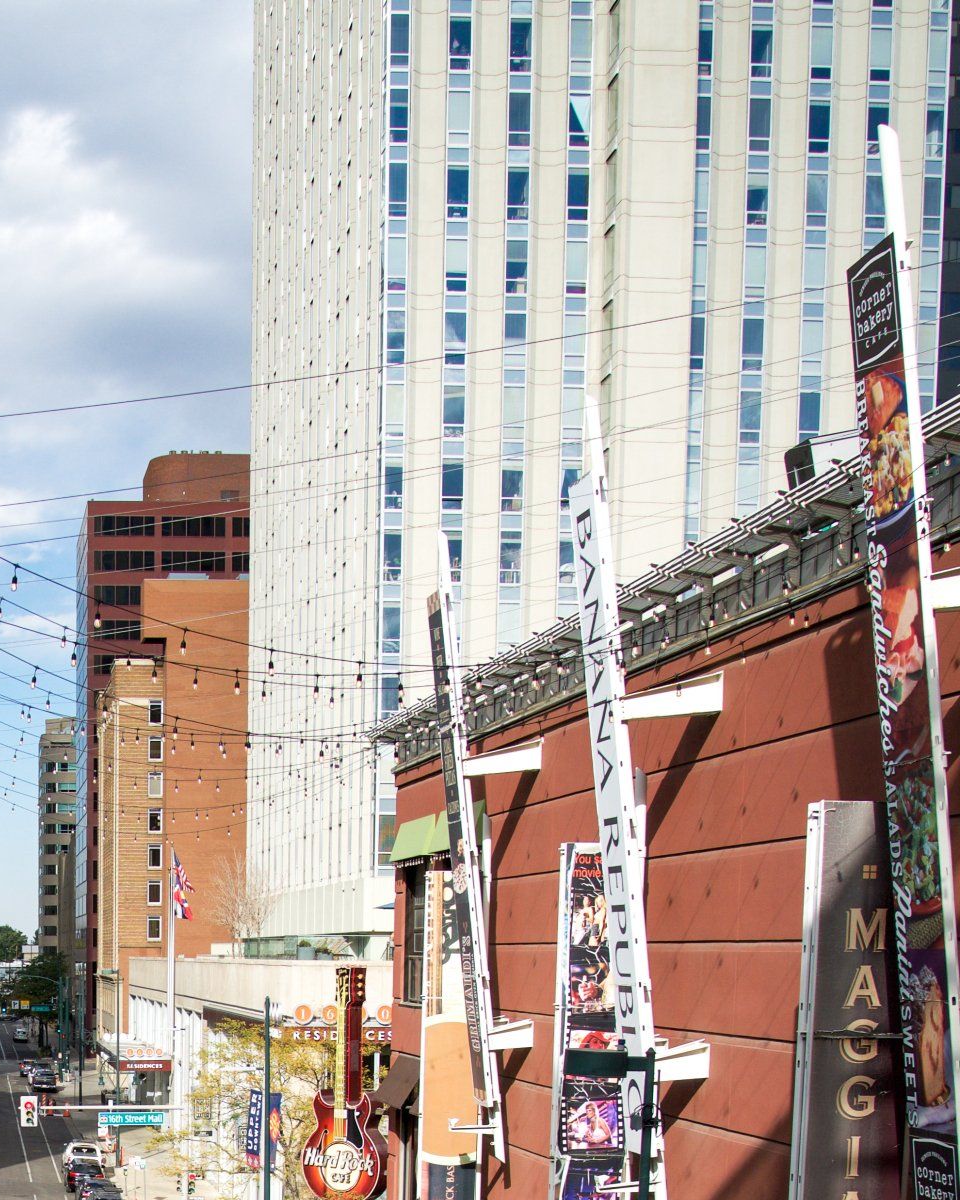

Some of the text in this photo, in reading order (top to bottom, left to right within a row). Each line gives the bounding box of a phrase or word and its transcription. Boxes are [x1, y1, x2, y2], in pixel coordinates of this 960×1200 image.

[855, 281, 892, 319] corner
[856, 302, 894, 338] bakery
[865, 327, 888, 349] CAFE
[855, 377, 878, 541] BREAKFAST
[868, 543, 898, 764] Sandwiches
[576, 508, 643, 1122] BANANA REPUBLC
[883, 761, 904, 888] SALADS
[892, 883, 915, 1000] Panini
[461, 936, 481, 1053] GRIMALDI'S
[293, 1030, 392, 1041] RESIDCES
[901, 1001, 919, 1128] SWEETS
[108, 1113, 163, 1123] 16th Street Mall
[247, 1093, 258, 1150] UPPER
[304, 1147, 374, 1177] Hard Rock
[917, 1166, 953, 1186] corner
